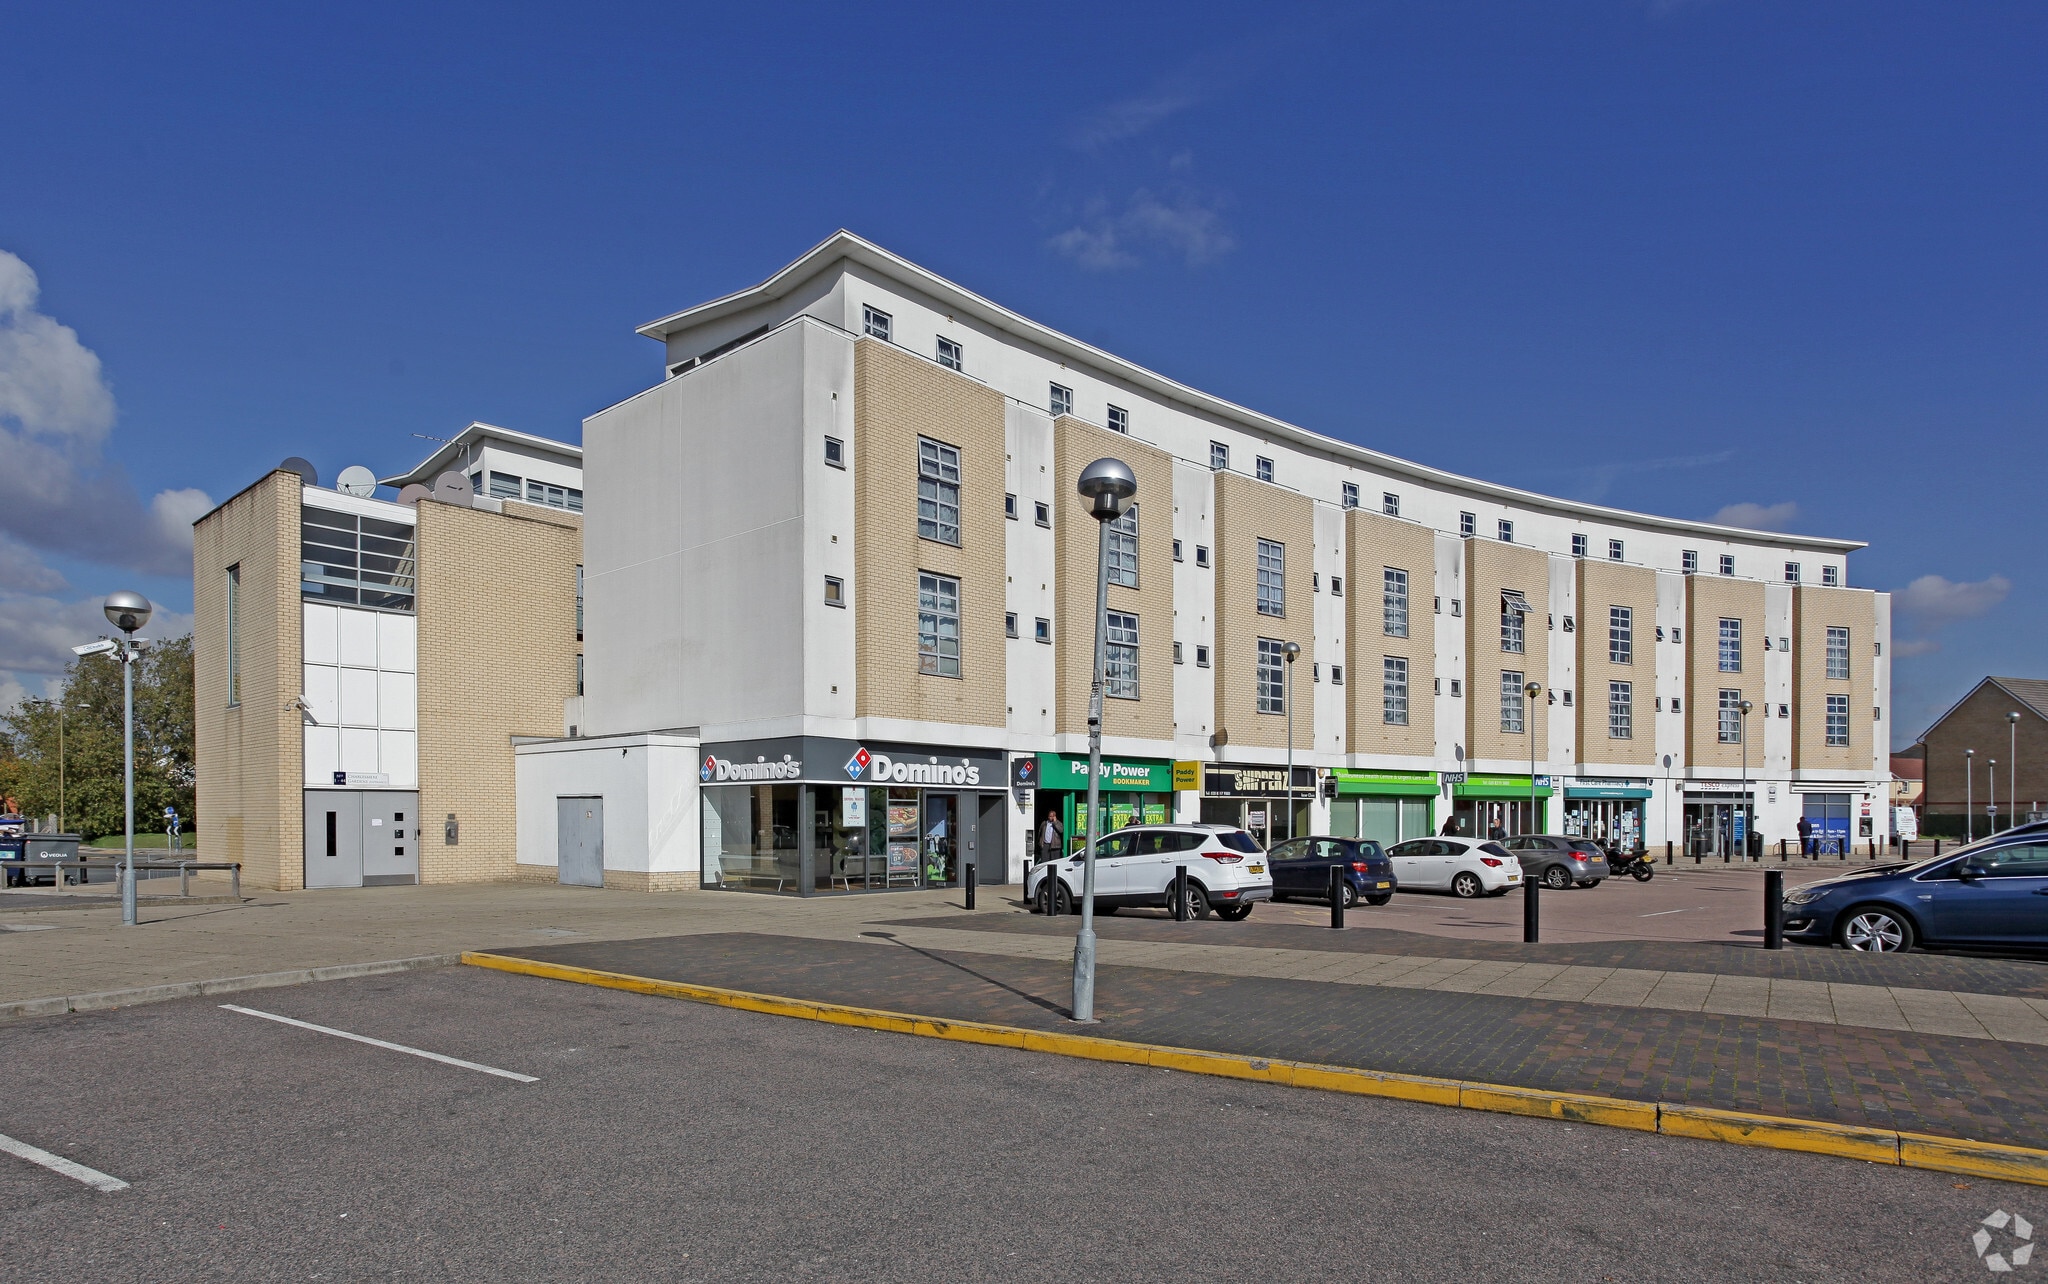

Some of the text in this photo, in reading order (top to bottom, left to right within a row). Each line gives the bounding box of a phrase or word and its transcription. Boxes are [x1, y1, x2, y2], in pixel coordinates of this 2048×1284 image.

[716, 754, 800, 781] Domino's
[871, 756, 980, 785] Domino's
[1071, 761, 1150, 778] Pady Power
[1113, 778, 1150, 786] BOOKMAKER
[1234, 770, 1289, 791] SNIPPERZ
[1444, 774, 1463, 782] NHS
[1535, 778, 1549, 786] NHS
[1145, 814, 1163, 823] EXTRA
